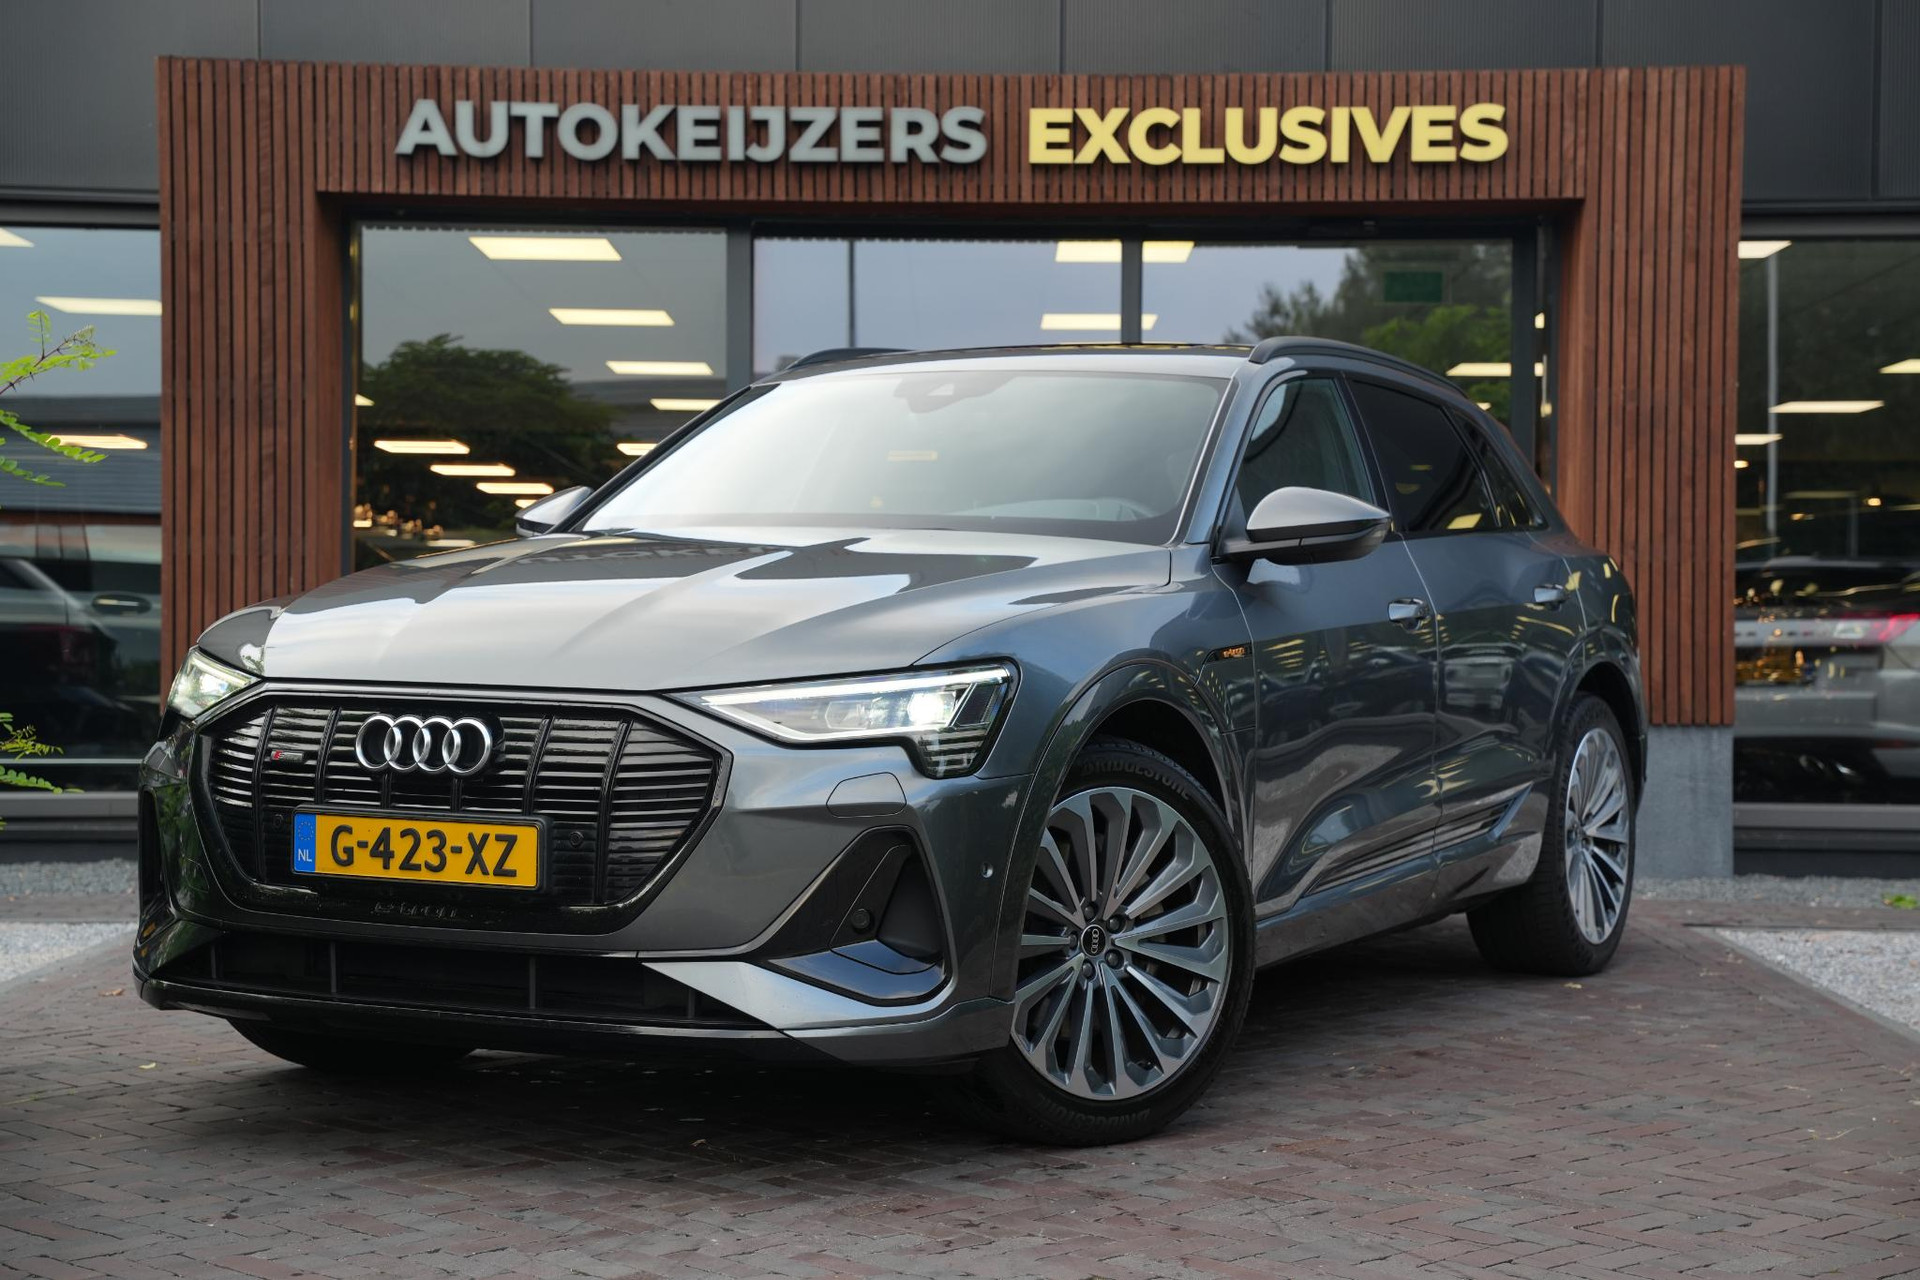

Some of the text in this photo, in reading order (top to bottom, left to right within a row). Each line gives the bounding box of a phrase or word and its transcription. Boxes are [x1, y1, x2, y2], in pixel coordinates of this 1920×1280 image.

[395, 98, 1509, 166] AUTOKEIJZERS EXCLUSIVES
[298, 848, 313, 862] NL
[330, 824, 518, 878] G-423-XZ
